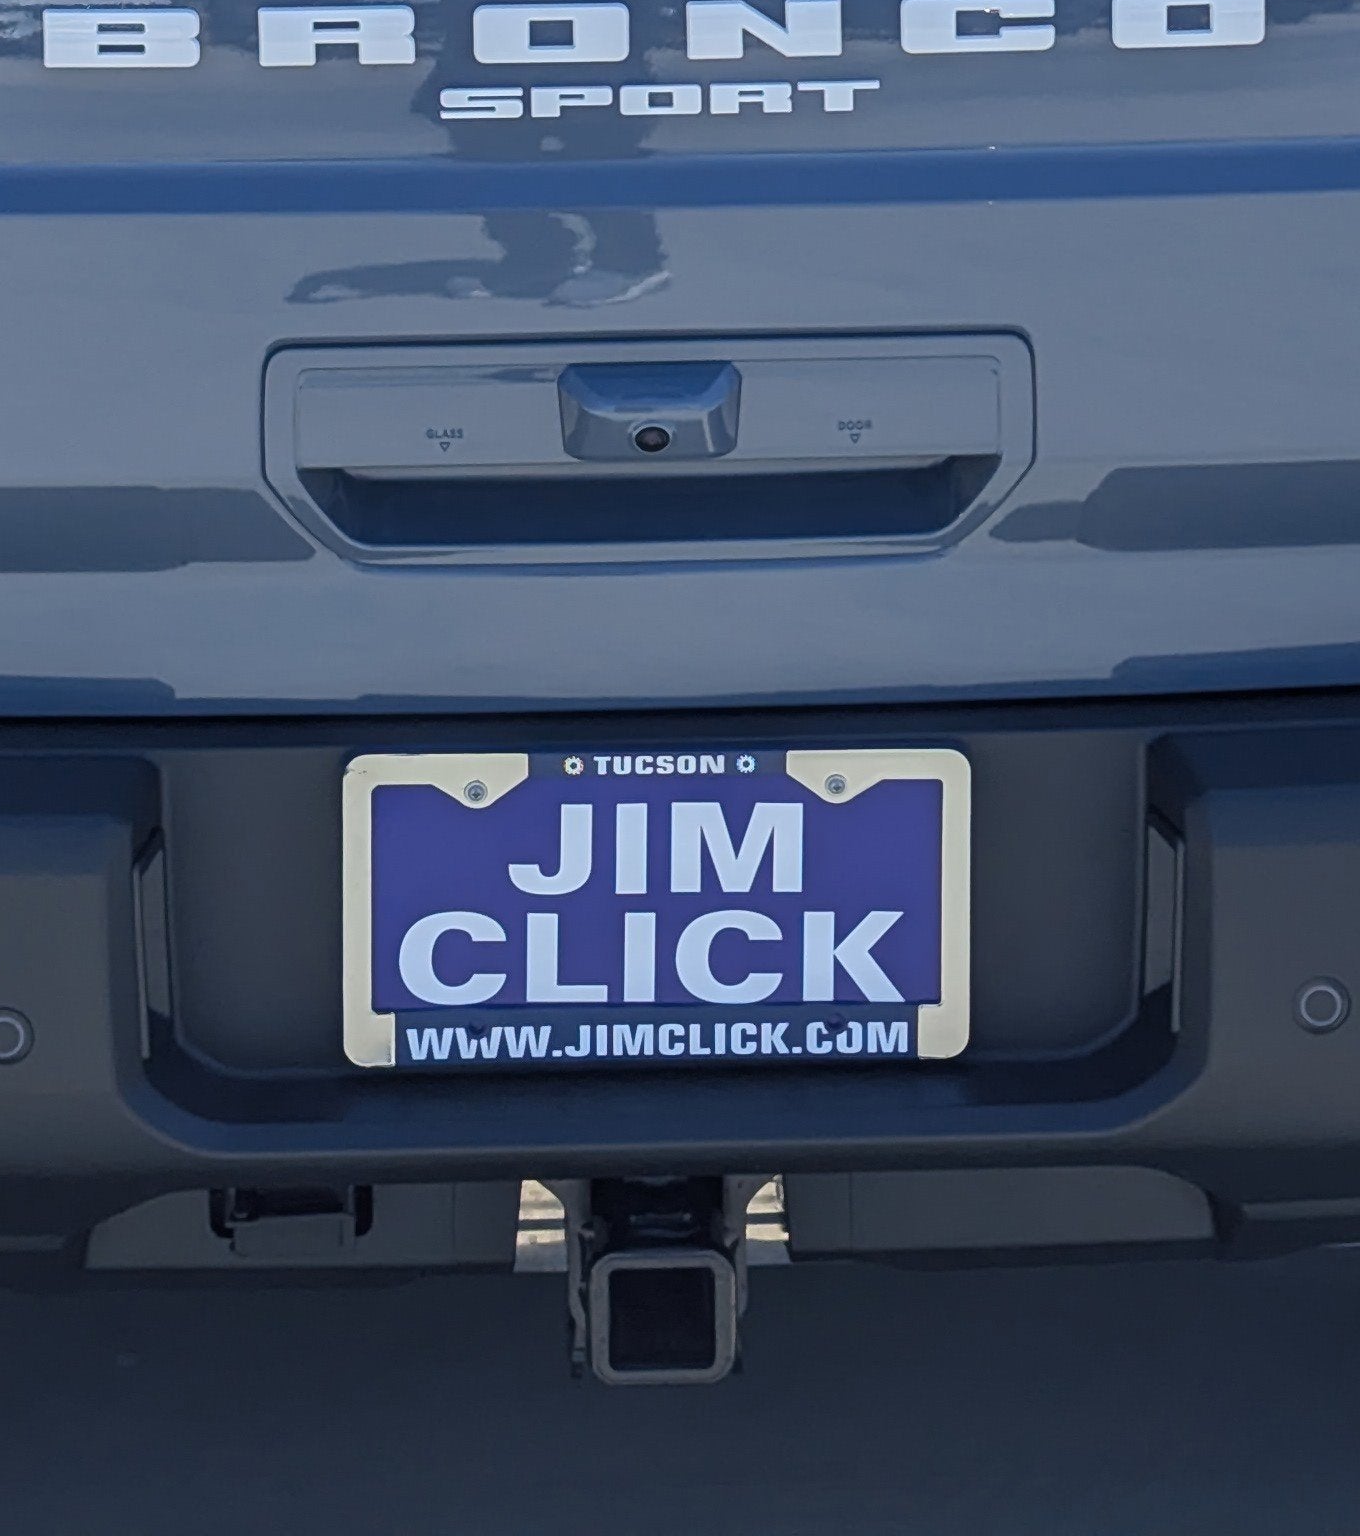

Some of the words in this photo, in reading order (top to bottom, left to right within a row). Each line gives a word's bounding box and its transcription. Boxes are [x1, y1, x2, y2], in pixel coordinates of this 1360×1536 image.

[439, 78, 880, 120] SPORT
[426, 427, 465, 439] GLASS
[839, 420, 873, 431] DOOR
[593, 754, 725, 776] TUCSON
[507, 801, 804, 895] JIM
[398, 909, 907, 1005] CLICK
